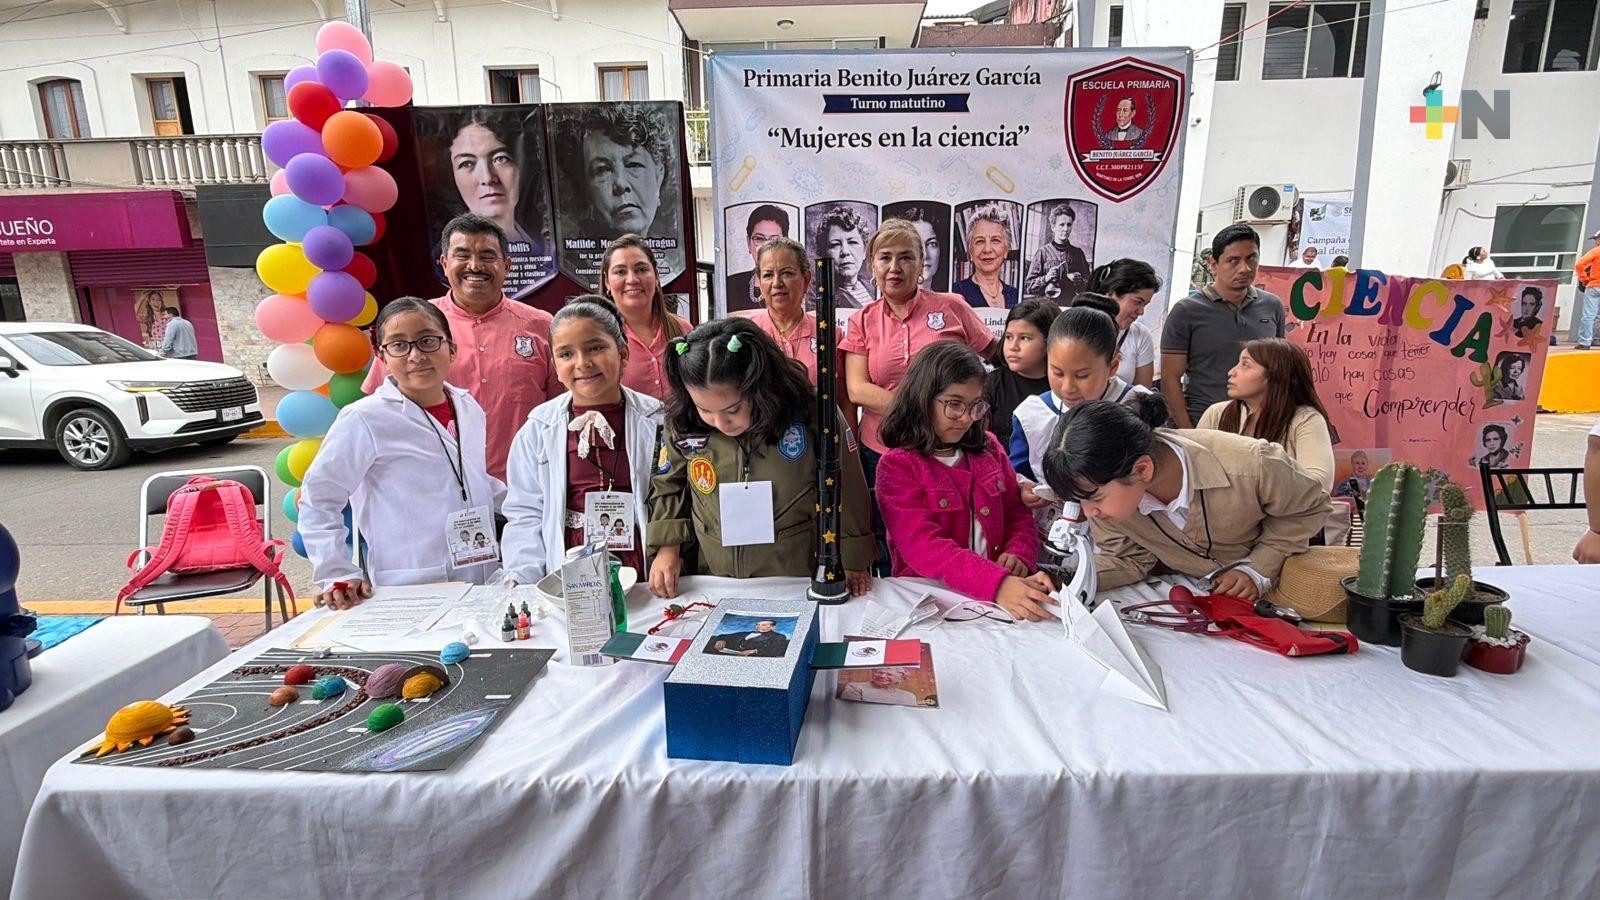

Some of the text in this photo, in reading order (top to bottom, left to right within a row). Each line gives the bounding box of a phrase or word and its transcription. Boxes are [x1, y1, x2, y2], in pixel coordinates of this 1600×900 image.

[743, 65, 1041, 90] Primaria Benito Juárez García
[1082, 80, 1170, 90] ESCUELA PRIMARIA
[850, 96, 946, 109] Turno matutino
[878, 131, 906, 147] en
[911, 125, 932, 147] la
[0, 217, 54, 236] UEÑO
[27, 238, 56, 246] Experta
[565, 239, 596, 249] Matilde
[1307, 236, 1346, 245] Campaña
[1290, 267, 1492, 363] CIENCIA
[1306, 322, 1398, 347] En la vida
[1319, 343, 1337, 365] hay
[1348, 349, 1377, 360] cosas
[1343, 365, 1365, 386] hay
[1373, 366, 1416, 382] cosas
[1334, 387, 1476, 431] que Comprender
[566, 582, 579, 591] SAN
